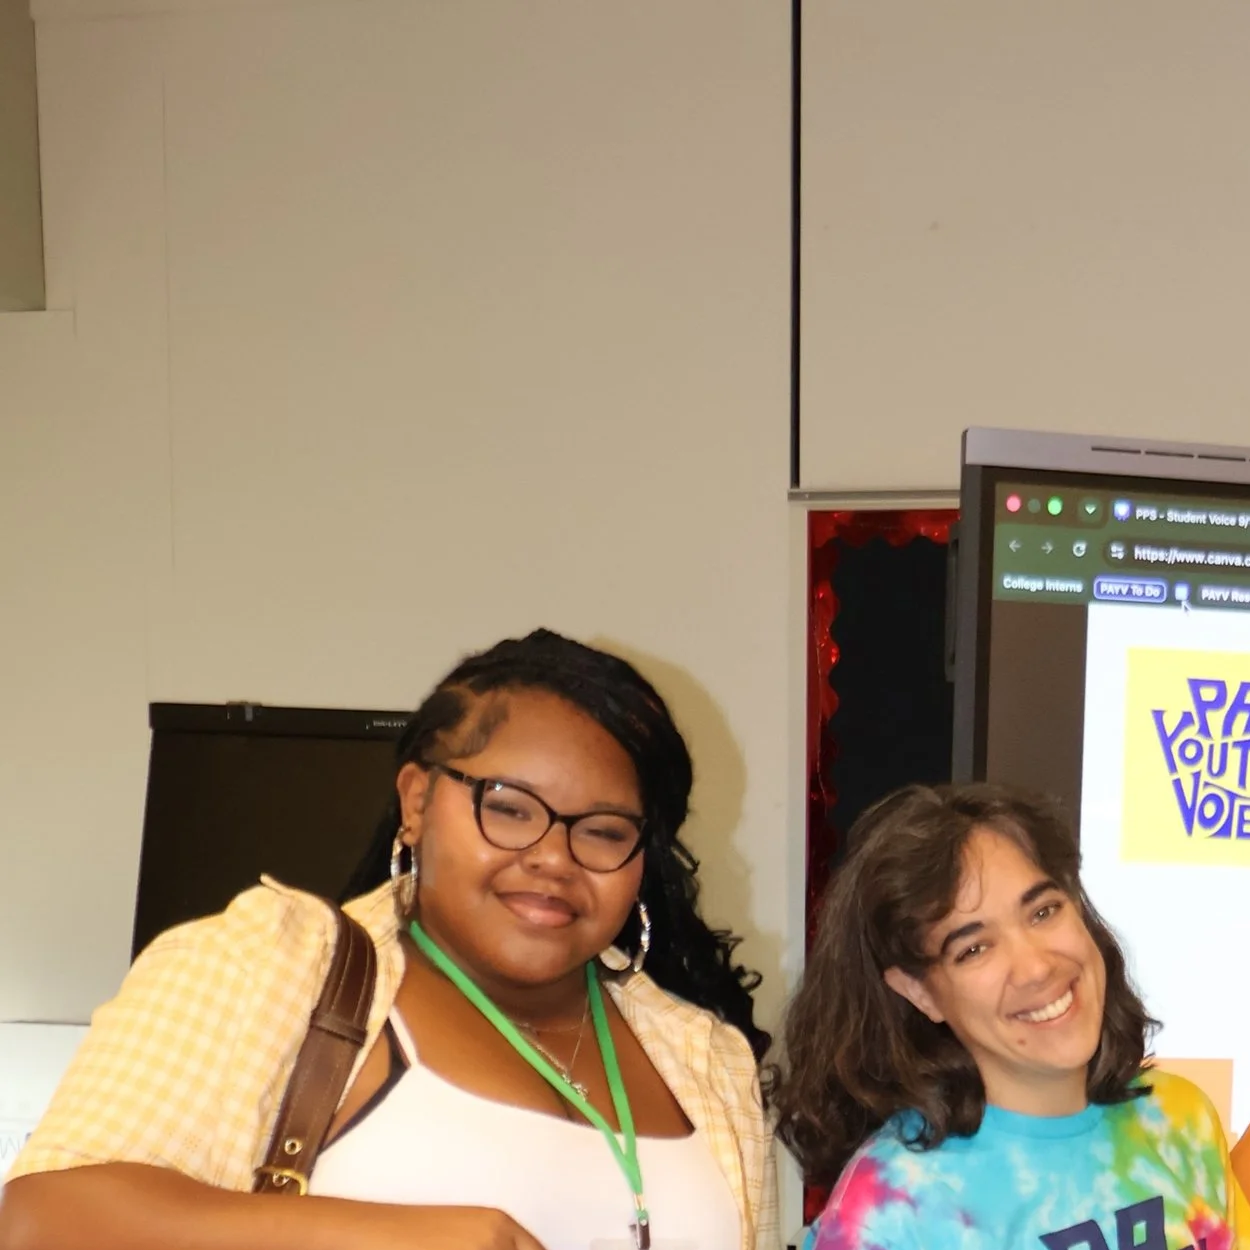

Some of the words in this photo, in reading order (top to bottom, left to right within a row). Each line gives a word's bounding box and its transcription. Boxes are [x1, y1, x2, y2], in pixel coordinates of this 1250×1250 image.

[1136, 507, 1157, 521] PPS
[1166, 509, 1207, 525] Student
[1208, 514, 1236, 527] Voice
[1003, 575, 1044, 592] College
[1045, 579, 1083, 593] Interns
[1130, 584, 1143, 596] To
[1145, 586, 1161, 598] Do
[1201, 588, 1230, 602] PAYV
